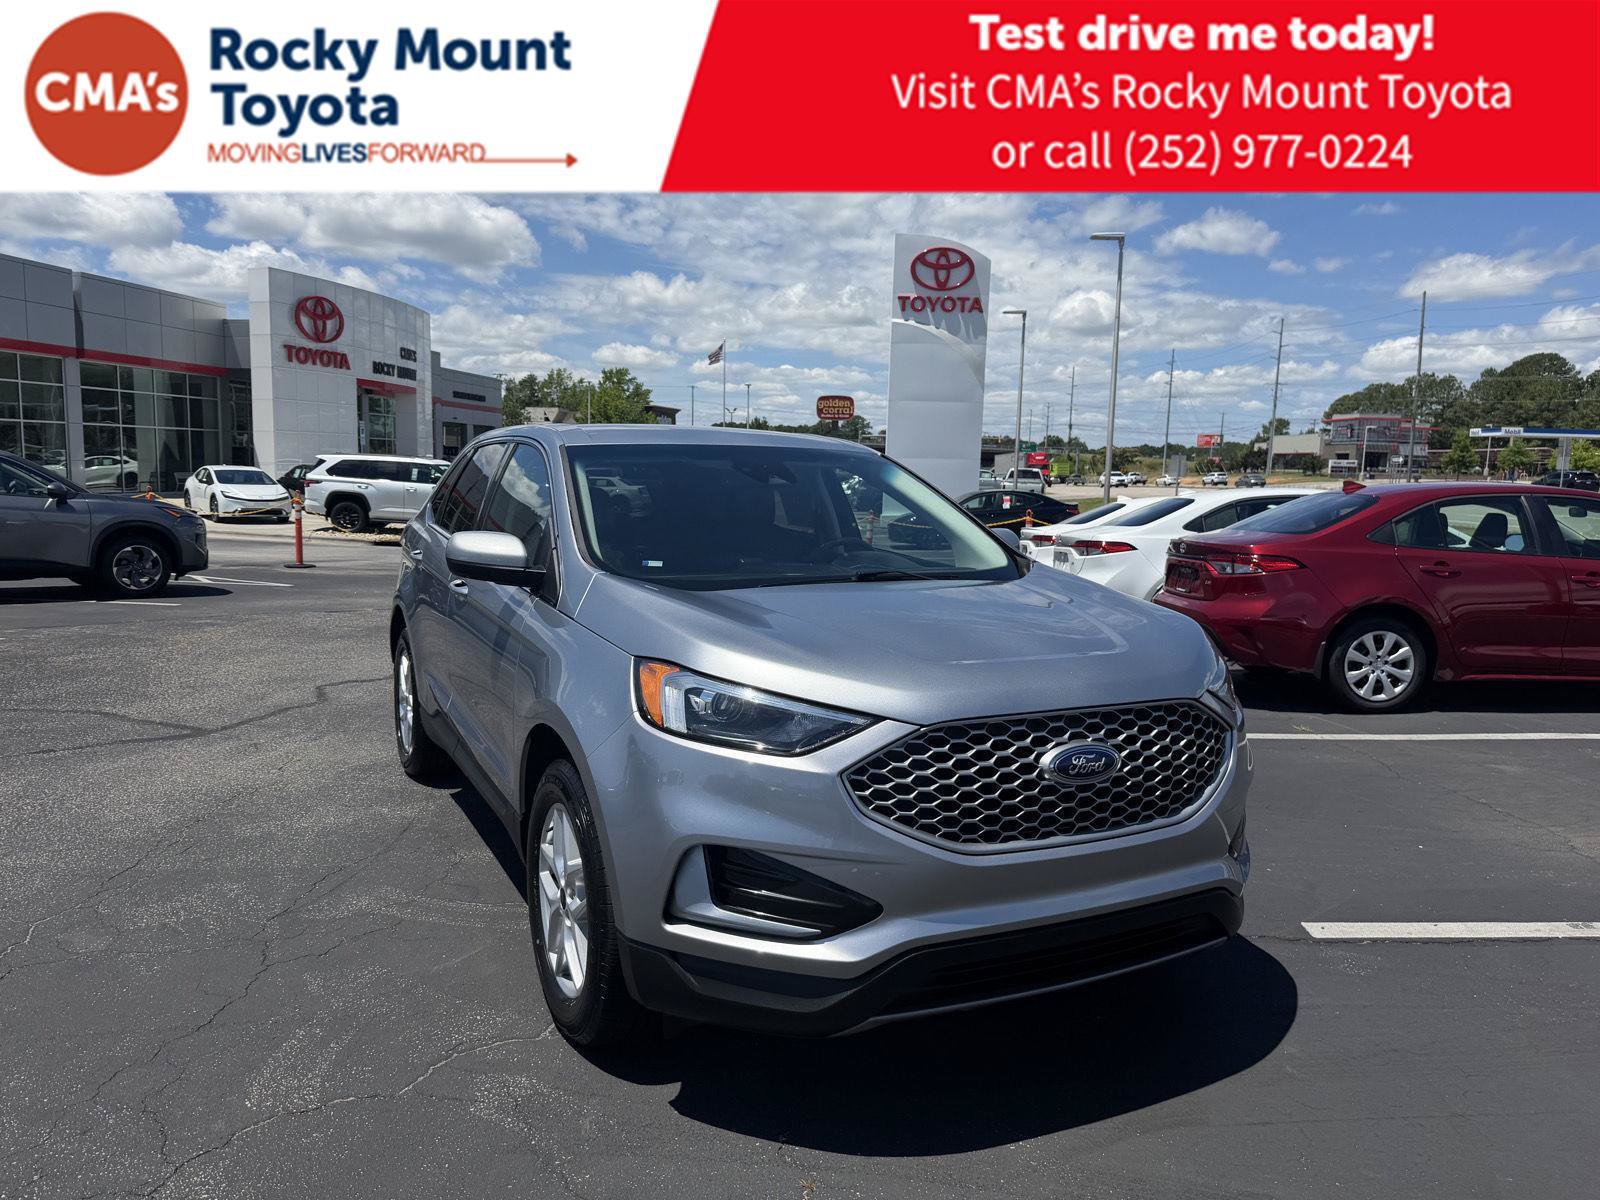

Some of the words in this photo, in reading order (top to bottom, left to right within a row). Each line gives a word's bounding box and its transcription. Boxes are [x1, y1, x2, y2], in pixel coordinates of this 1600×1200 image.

[897, 294, 984, 314] TOYOTA
[283, 344, 352, 370] TOYOTA
[818, 399, 851, 409] golden
[822, 406, 853, 414] corral
[1068, 753, 1106, 775] Ford
